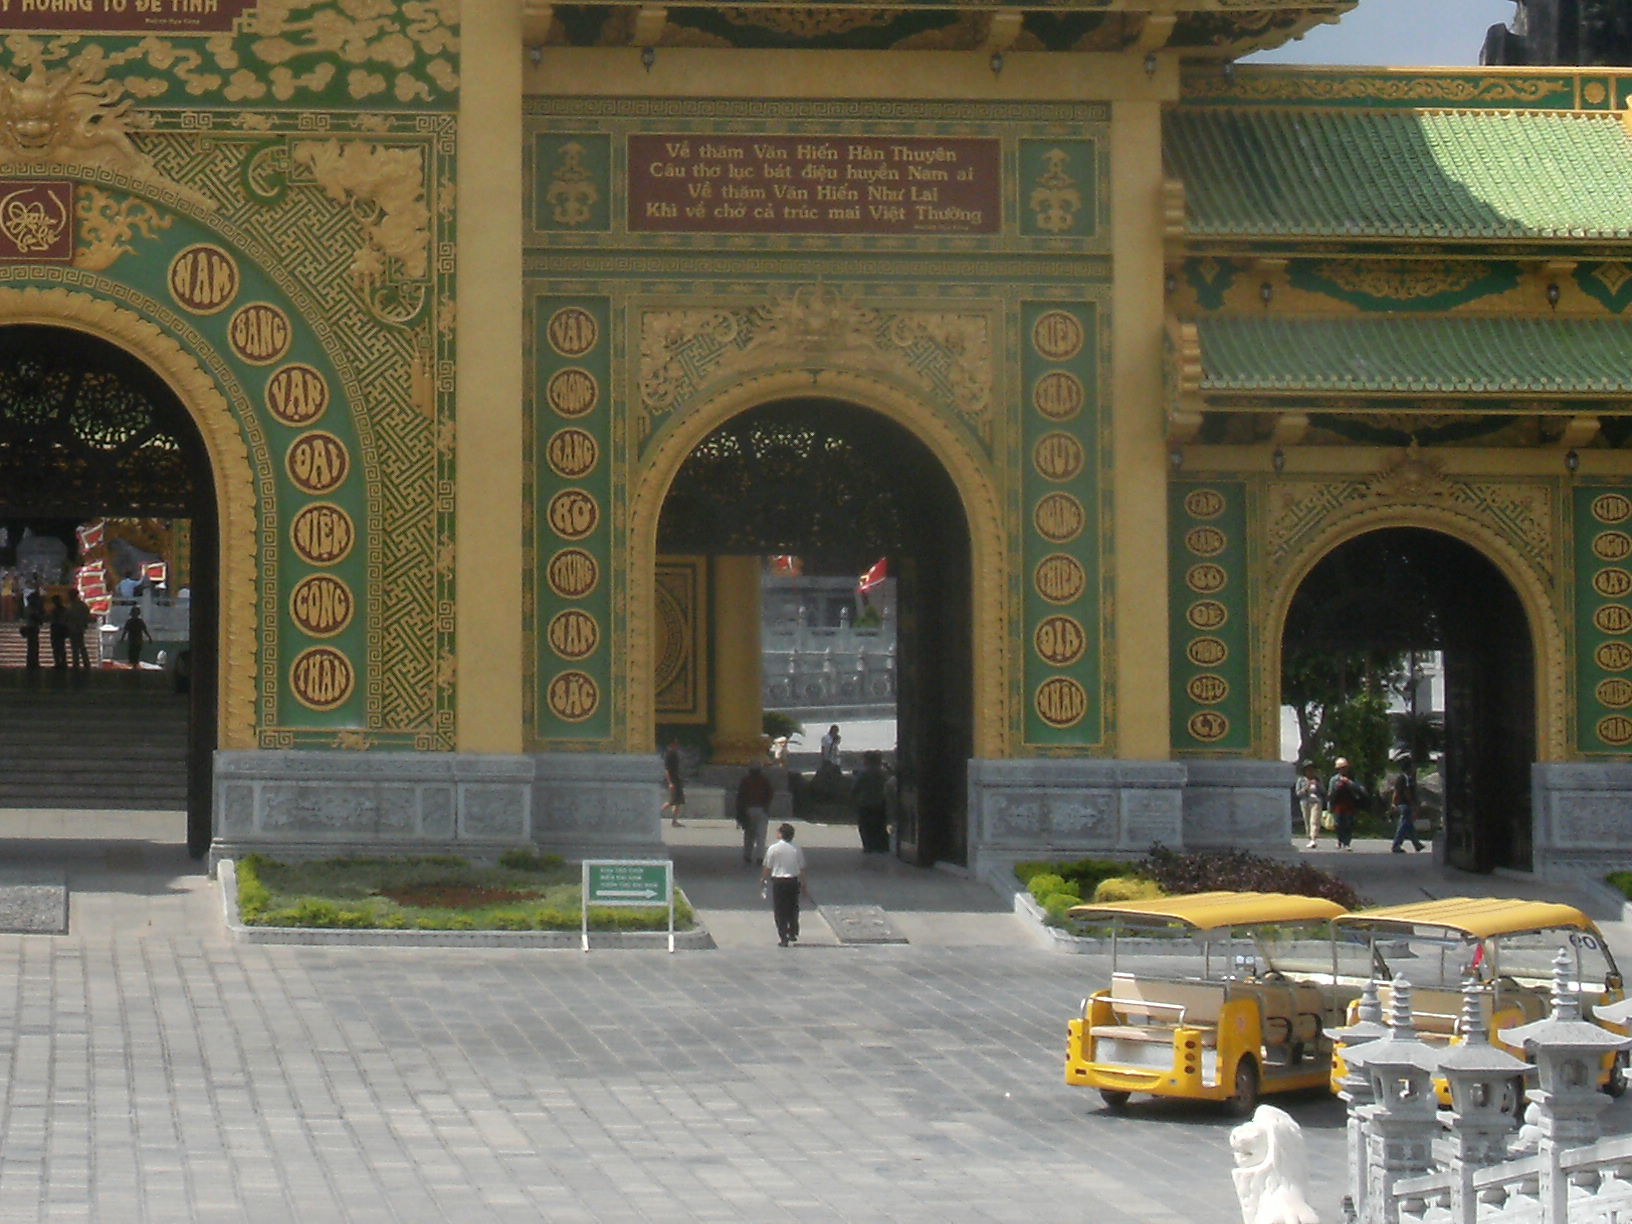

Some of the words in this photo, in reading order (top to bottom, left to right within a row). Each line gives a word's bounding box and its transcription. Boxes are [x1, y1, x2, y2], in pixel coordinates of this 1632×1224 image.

[176, 252, 232, 306] NAM
[234, 310, 284, 358] BANG
[553, 312, 593, 352] VĂN
[272, 371, 322, 419] VẠN
[292, 439, 342, 487] ĐẠI
[296, 582, 346, 630] CÔNG
[554, 676, 594, 716] BẮC
